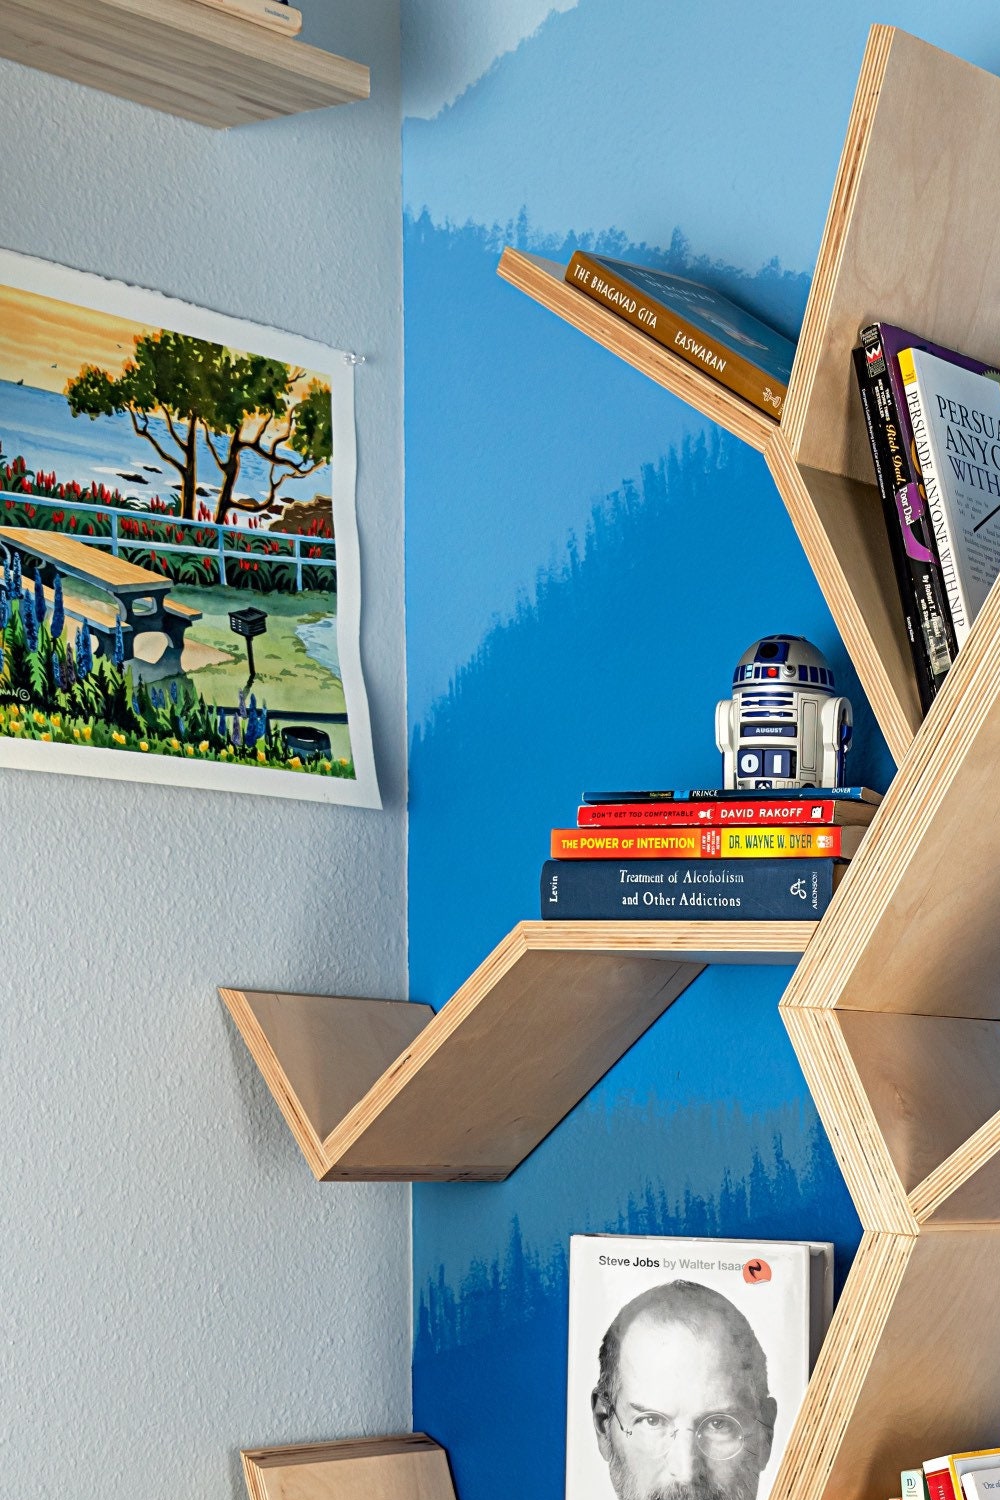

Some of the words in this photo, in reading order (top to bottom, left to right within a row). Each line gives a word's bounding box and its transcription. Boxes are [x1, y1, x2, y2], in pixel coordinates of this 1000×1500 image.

[573, 264, 590, 284] THE
[590, 276, 636, 313] BHAGAVAD
[638, 307, 657, 328] GITA
[674, 331, 726, 373] EASWARAN
[906, 390, 935, 469] PERSUADE
[949, 455, 1000, 498] WITH
[924, 475, 949, 543] ANYONE
[941, 549, 958, 593] WITH
[949, 595, 964, 627] NLP
[720, 809, 754, 818] DAVID
[759, 808, 803, 817] RAKOFF
[562, 840, 578, 849] THE
[580, 838, 619, 849] POWER
[622, 840, 634, 848] OF
[637, 838, 695, 849] INTENTION
[729, 835, 743, 849] DR.
[745, 835, 775, 849] WAYNE
[777, 835, 787, 848] W.
[790, 835, 812, 848] DYER
[619, 870, 663, 883] Treatment
[668, 870, 679, 883] of
[683, 869, 744, 883] Alcoholism
[550, 876, 559, 903] Levin
[622, 892, 638, 905] and
[643, 892, 675, 905] Other
[679, 893, 741, 907] Addictions
[598, 1255, 631, 1268] Steve
[632, 1256, 660, 1269] Jobs
[662, 1257, 677, 1271] by
[678, 1258, 715, 1271] Walter
[938, 1485, 946, 1500] THE
